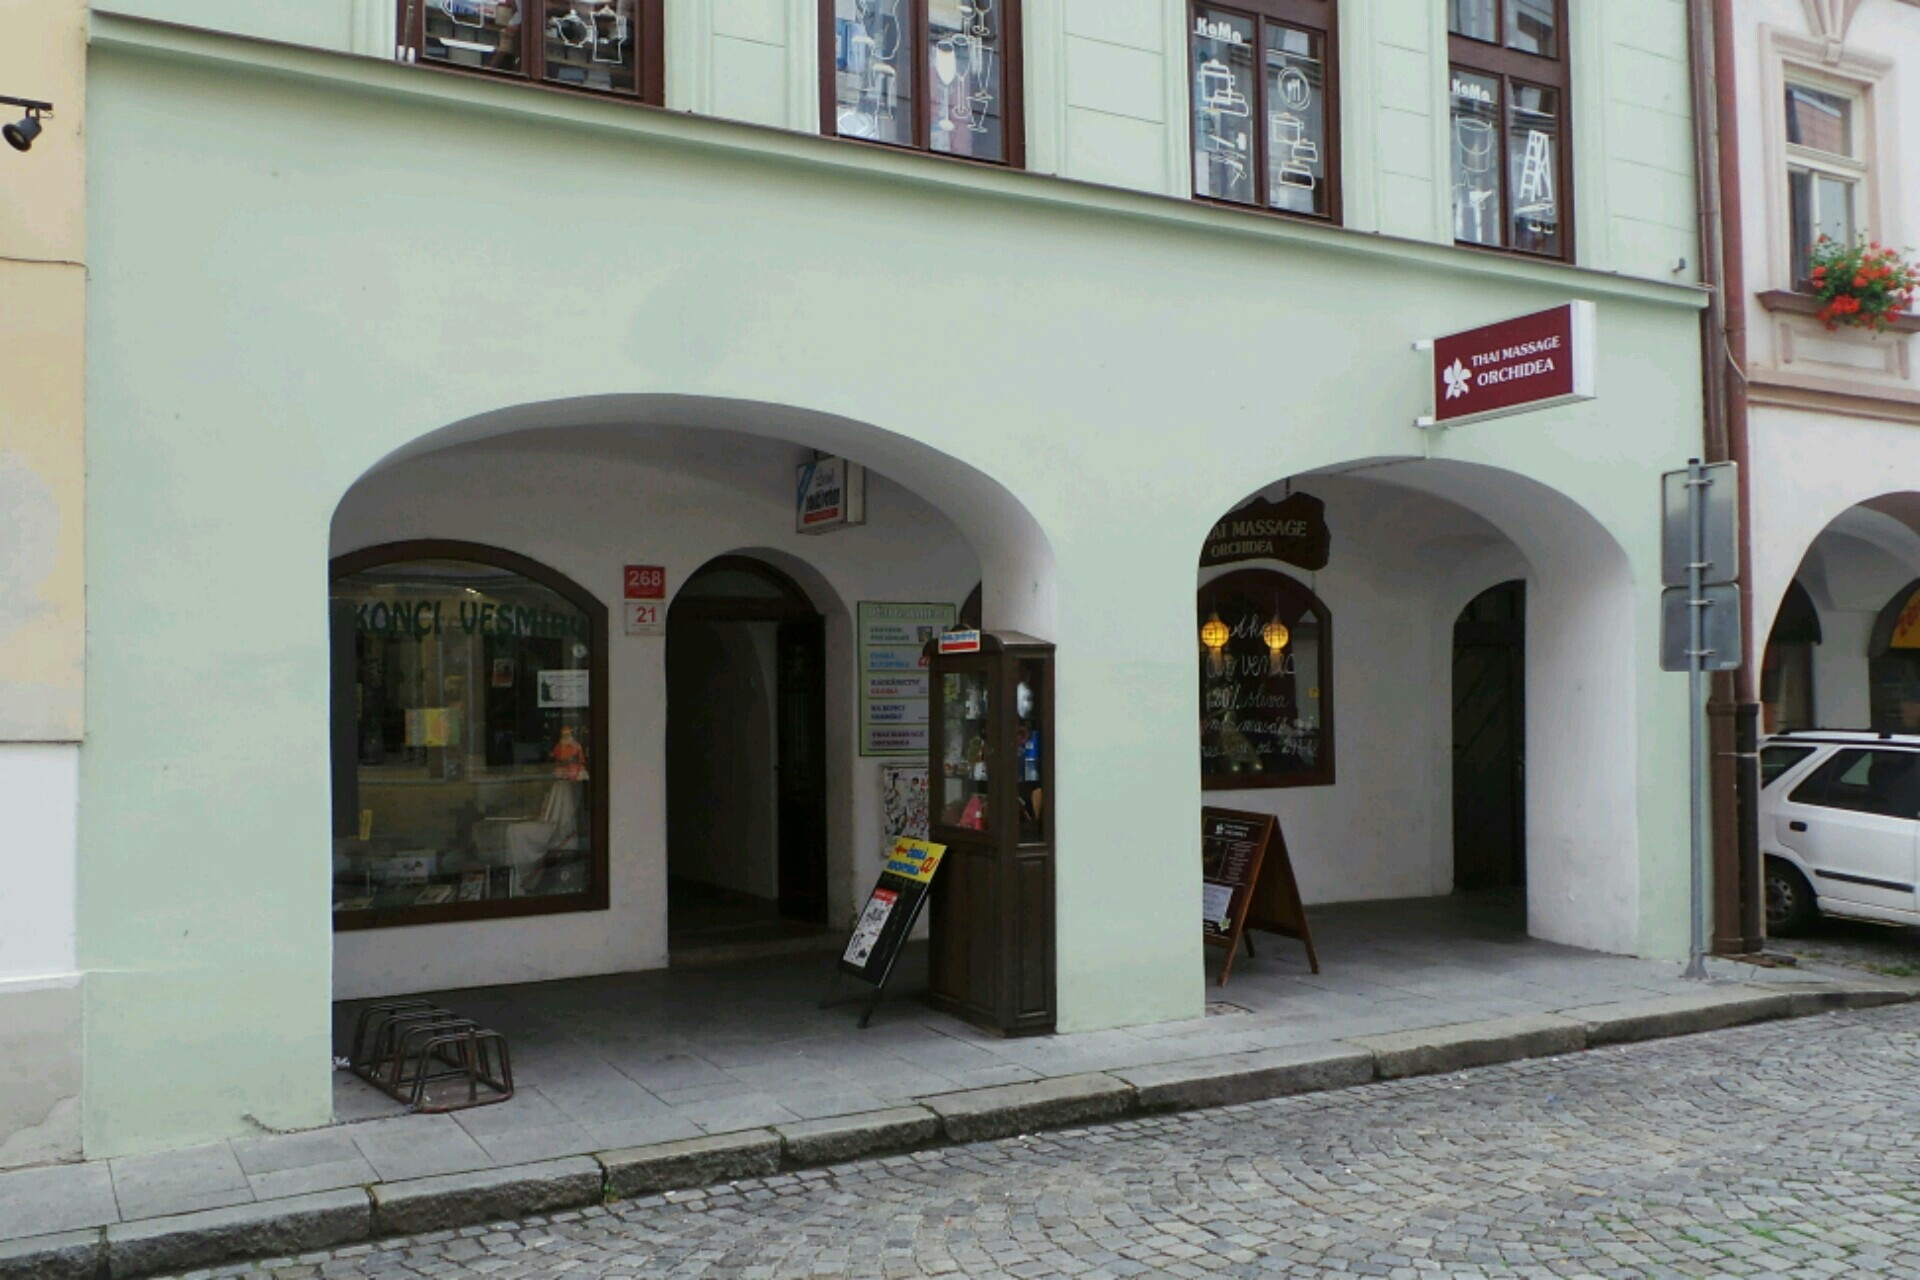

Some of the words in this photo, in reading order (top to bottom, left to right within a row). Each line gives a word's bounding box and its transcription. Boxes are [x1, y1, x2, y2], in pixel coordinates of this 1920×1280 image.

[1471, 348, 1500, 367] THAI
[1502, 335, 1561, 360] MASSAGE
[1477, 357, 1555, 386] ORCHIDEA
[1231, 519, 1308, 538] MASSAGE
[1211, 540, 1274, 558] ORCHIDEA
[629, 570, 661, 586] 268
[636, 606, 657, 623] 21
